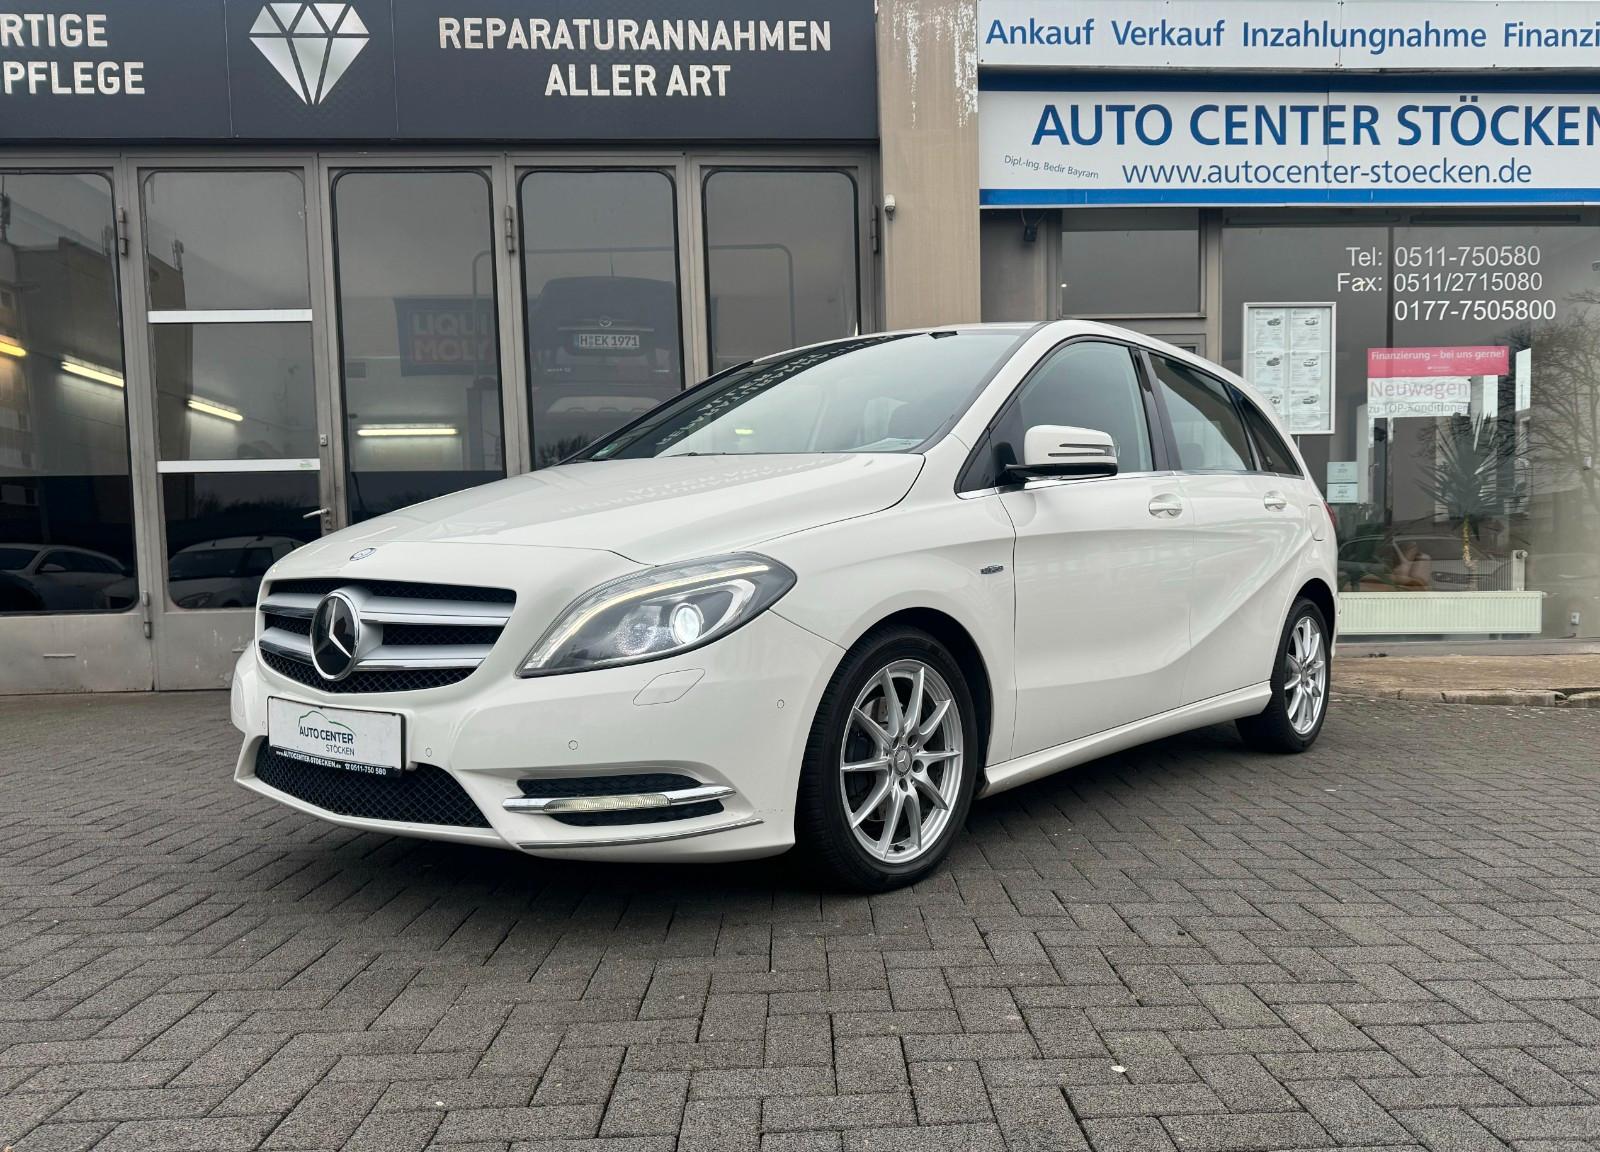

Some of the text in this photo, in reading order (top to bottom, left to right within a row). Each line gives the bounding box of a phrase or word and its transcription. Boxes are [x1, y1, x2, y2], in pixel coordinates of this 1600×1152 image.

[0, 13, 108, 47] RTIGE
[438, 17, 831, 51] REPARATURANNAHMEN
[985, 18, 1095, 46] Ankauf
[1111, 19, 1226, 47] Verkauf
[1243, 20, 1487, 55] Inzahlungnahme
[3, 61, 146, 95] PFLEGE
[544, 63, 731, 97] ALLER ART
[1031, 103, 1173, 146] AUTO
[1189, 104, 1381, 146] CENTER
[1004, 154, 1099, 179] Dipl.-Ing. Bedir Bayram
[1122, 157, 1532, 184] www.autocenter-stoecken.de
[1345, 245, 1541, 267] Tel: 0511-750580
[1337, 272, 1543, 293] Fax: 0511/2715080
[1394, 300, 1557, 321] 0177-7505800
[611, 336, 638, 347] 1971
[1371, 350, 1431, 361] Finanzierung
[1440, 350, 1454, 359] bei
[1456, 350, 1473, 358] uns
[1475, 349, 1505, 361] gerne!
[1370, 381, 1468, 399] Neuwagen
[299, 726, 354, 745] AUTO CENTER
